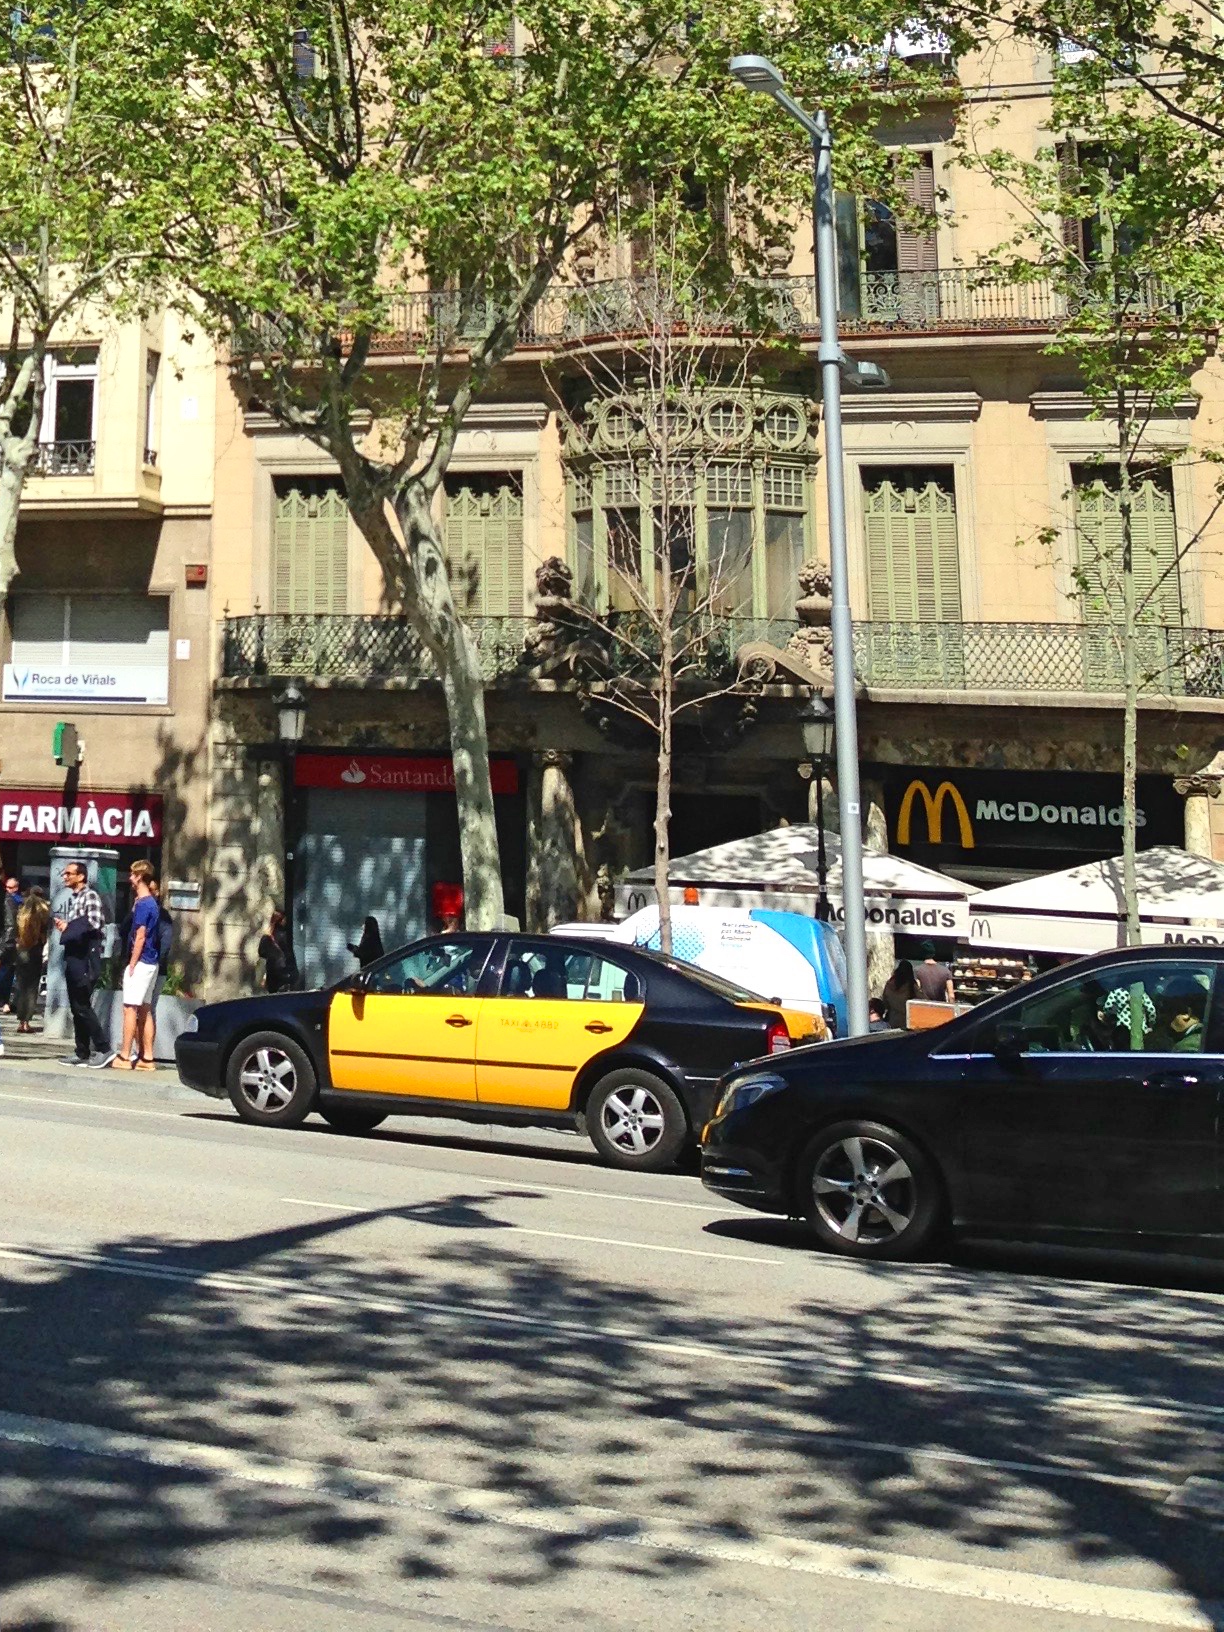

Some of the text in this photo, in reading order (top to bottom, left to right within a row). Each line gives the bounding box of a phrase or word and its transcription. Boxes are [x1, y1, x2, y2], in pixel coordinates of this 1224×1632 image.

[31, 673, 116, 686] Roca de Viñals
[1, 800, 155, 838] FARMÀCIA
[976, 799, 1147, 827] McDonalds
